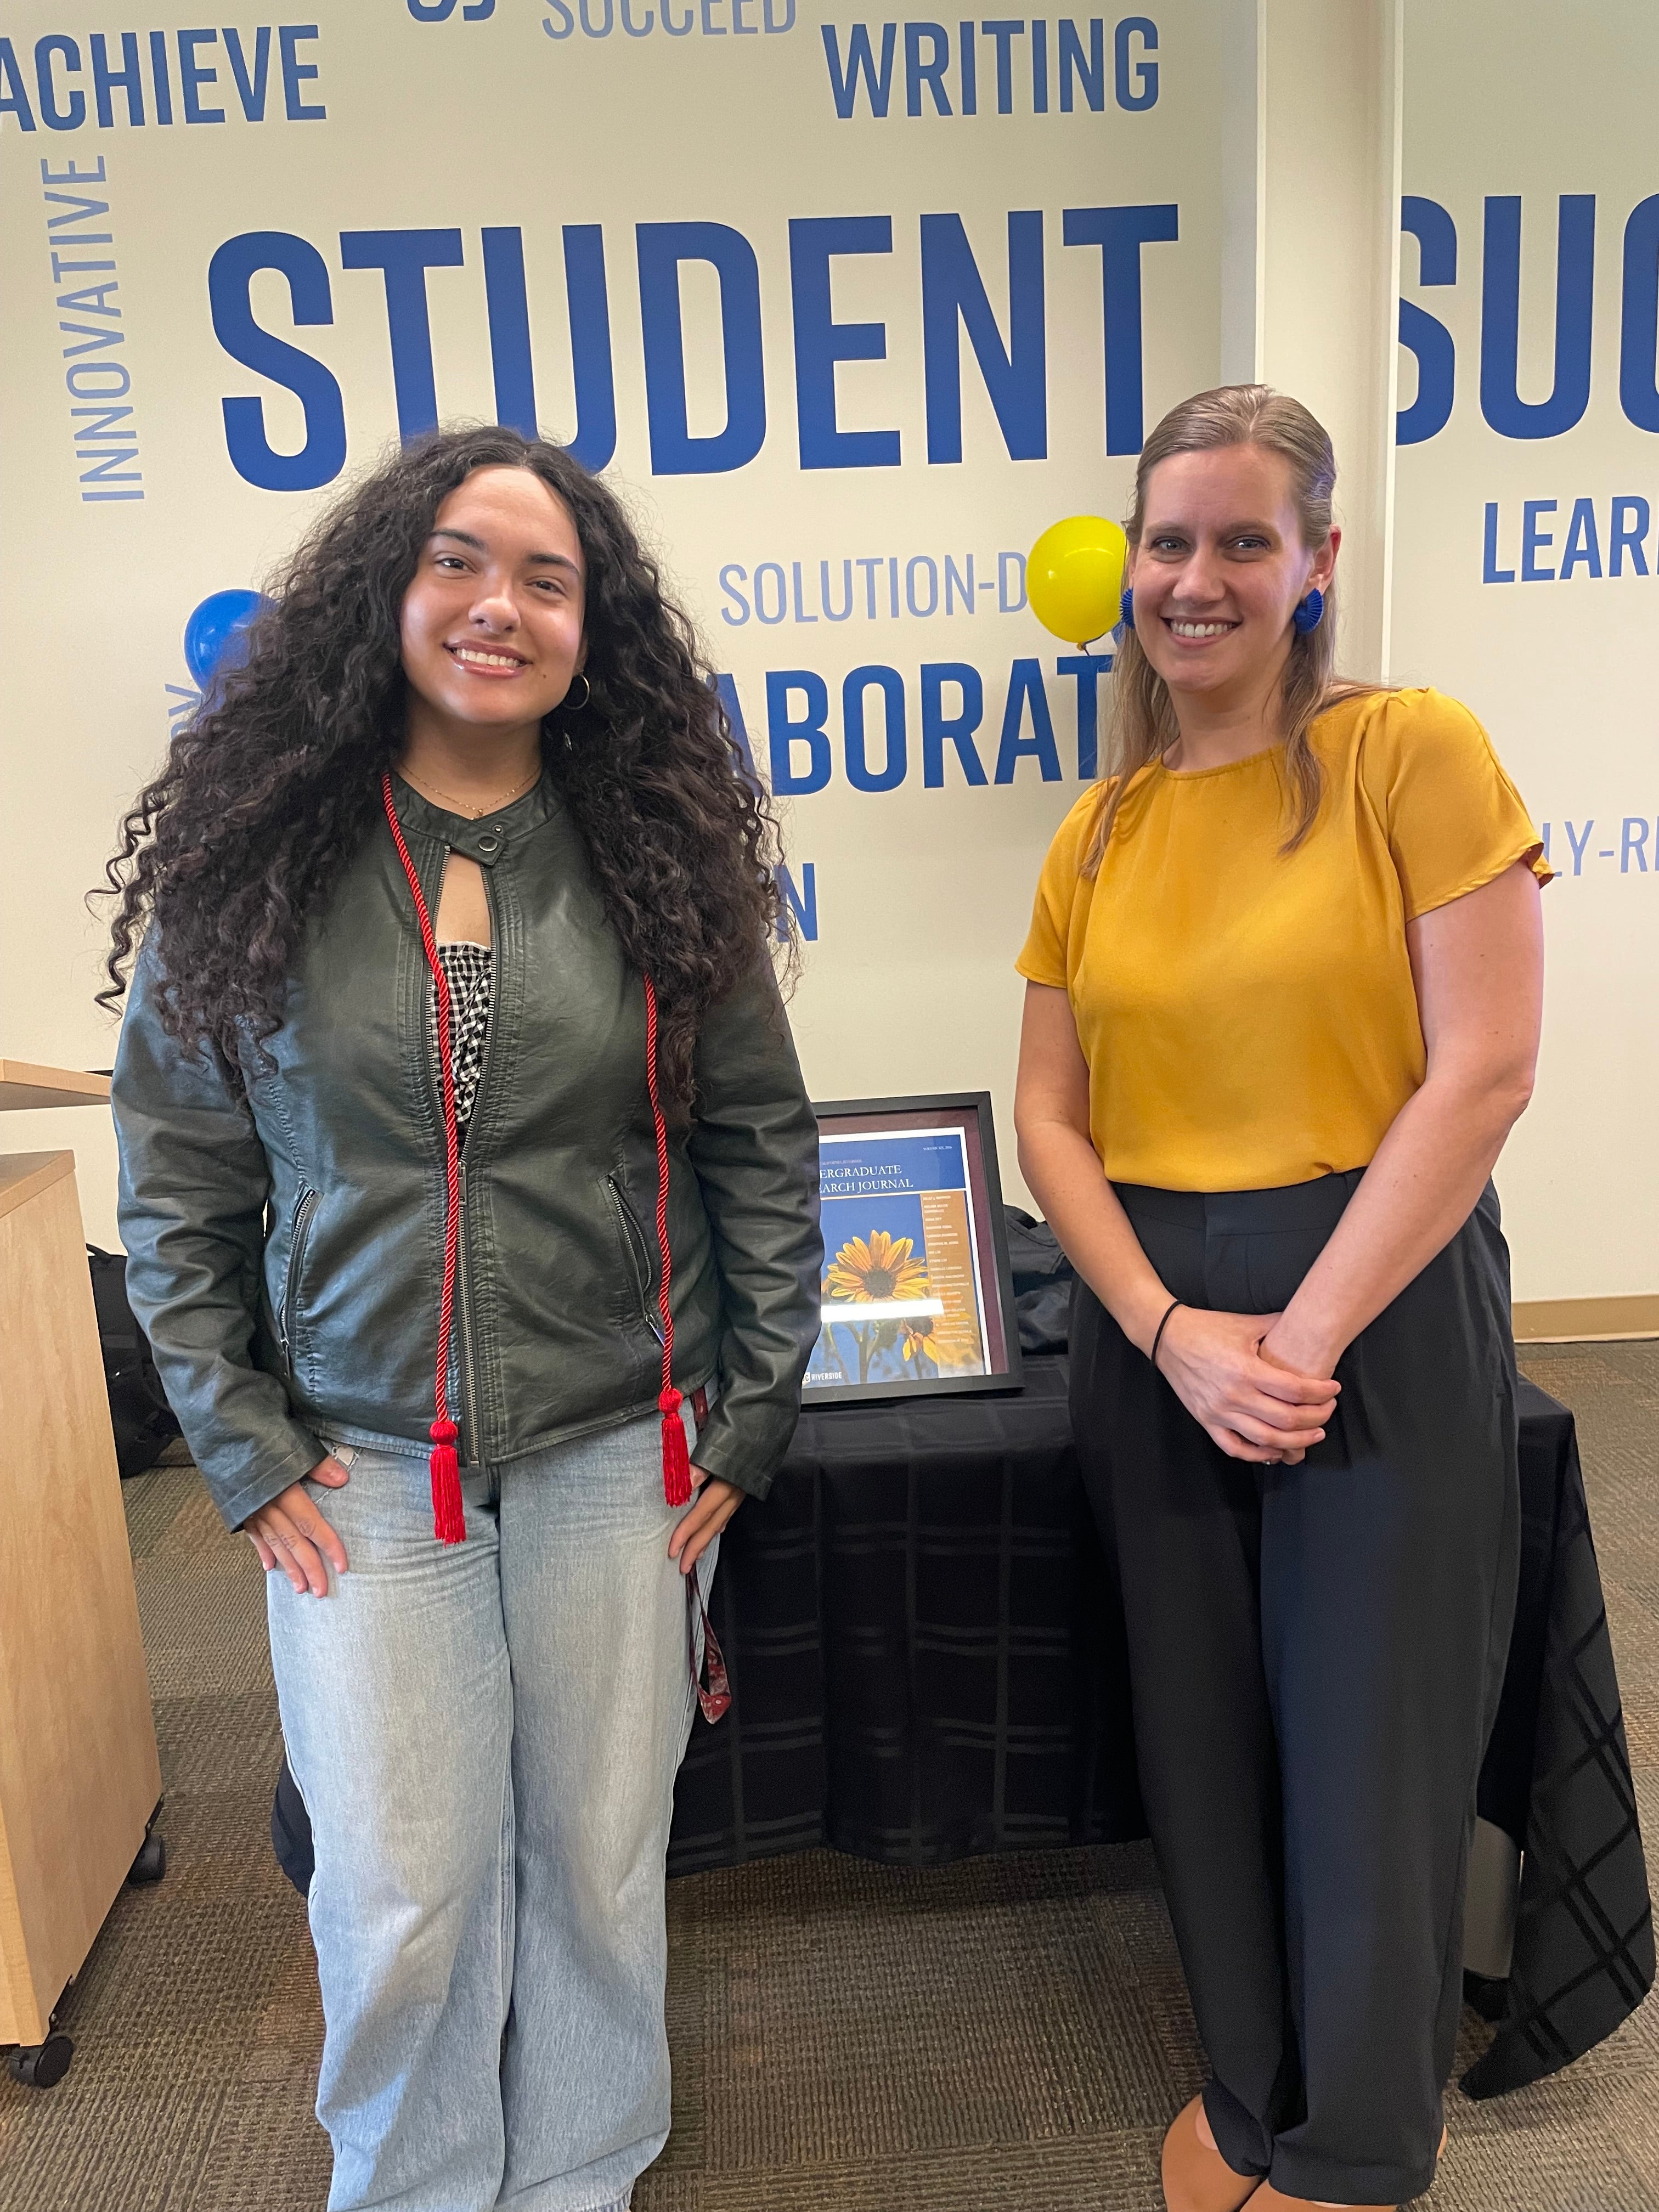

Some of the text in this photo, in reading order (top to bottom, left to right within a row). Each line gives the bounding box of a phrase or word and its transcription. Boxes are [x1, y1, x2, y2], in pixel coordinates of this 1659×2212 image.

[0, 25, 326, 132] ACHIEVE
[821, 17, 1159, 119] WRITING
[41, 155, 145, 501] INNOVATIVE
[208, 204, 1178, 492] STUDENT
[1483, 495, 1659, 584] LEAR
[1542, 816, 1659, 877] LY-R
[857, 1178, 913, 1194] JOURNAL
[811, 1372, 843, 1381] RIVERSIDE
